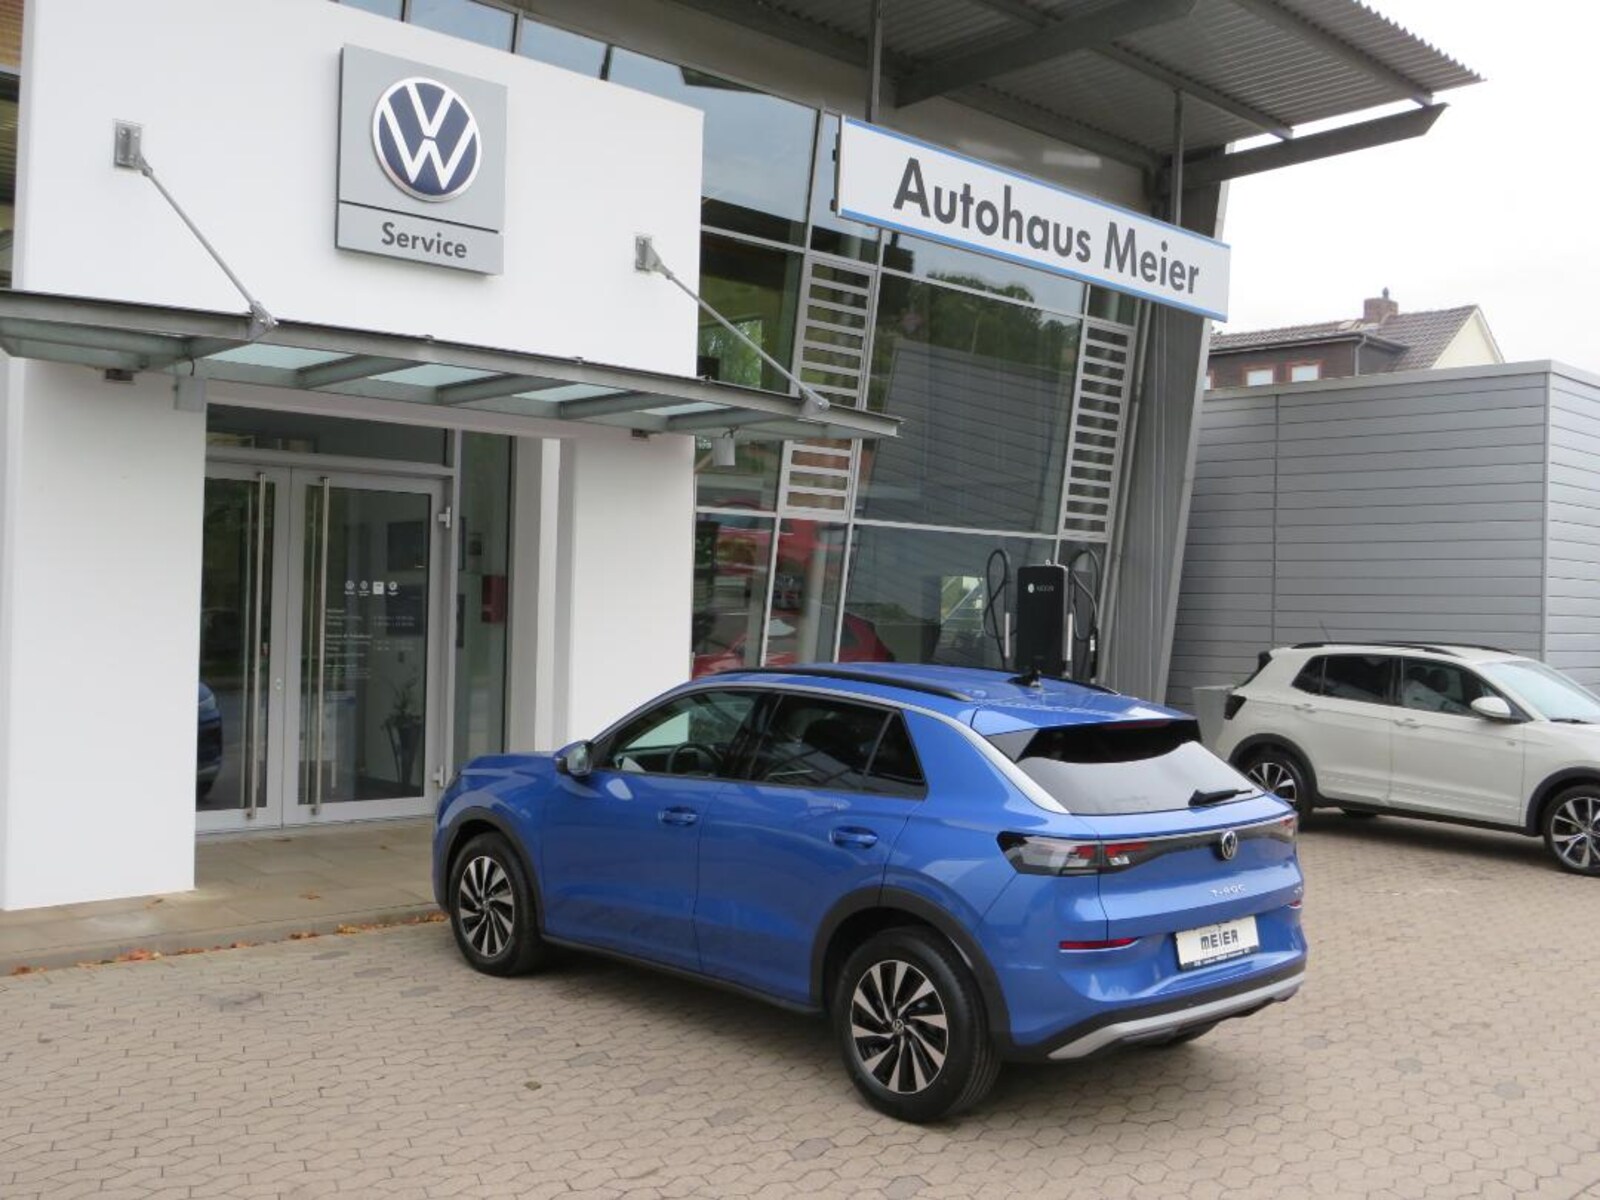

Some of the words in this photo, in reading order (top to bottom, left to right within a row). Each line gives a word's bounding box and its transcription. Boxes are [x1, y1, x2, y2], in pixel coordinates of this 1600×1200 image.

[381, 221, 467, 258] Service
[893, 157, 1091, 263] Autohaus
[1104, 221, 1200, 295] Meier
[1200, 929, 1239, 950] MEIER
